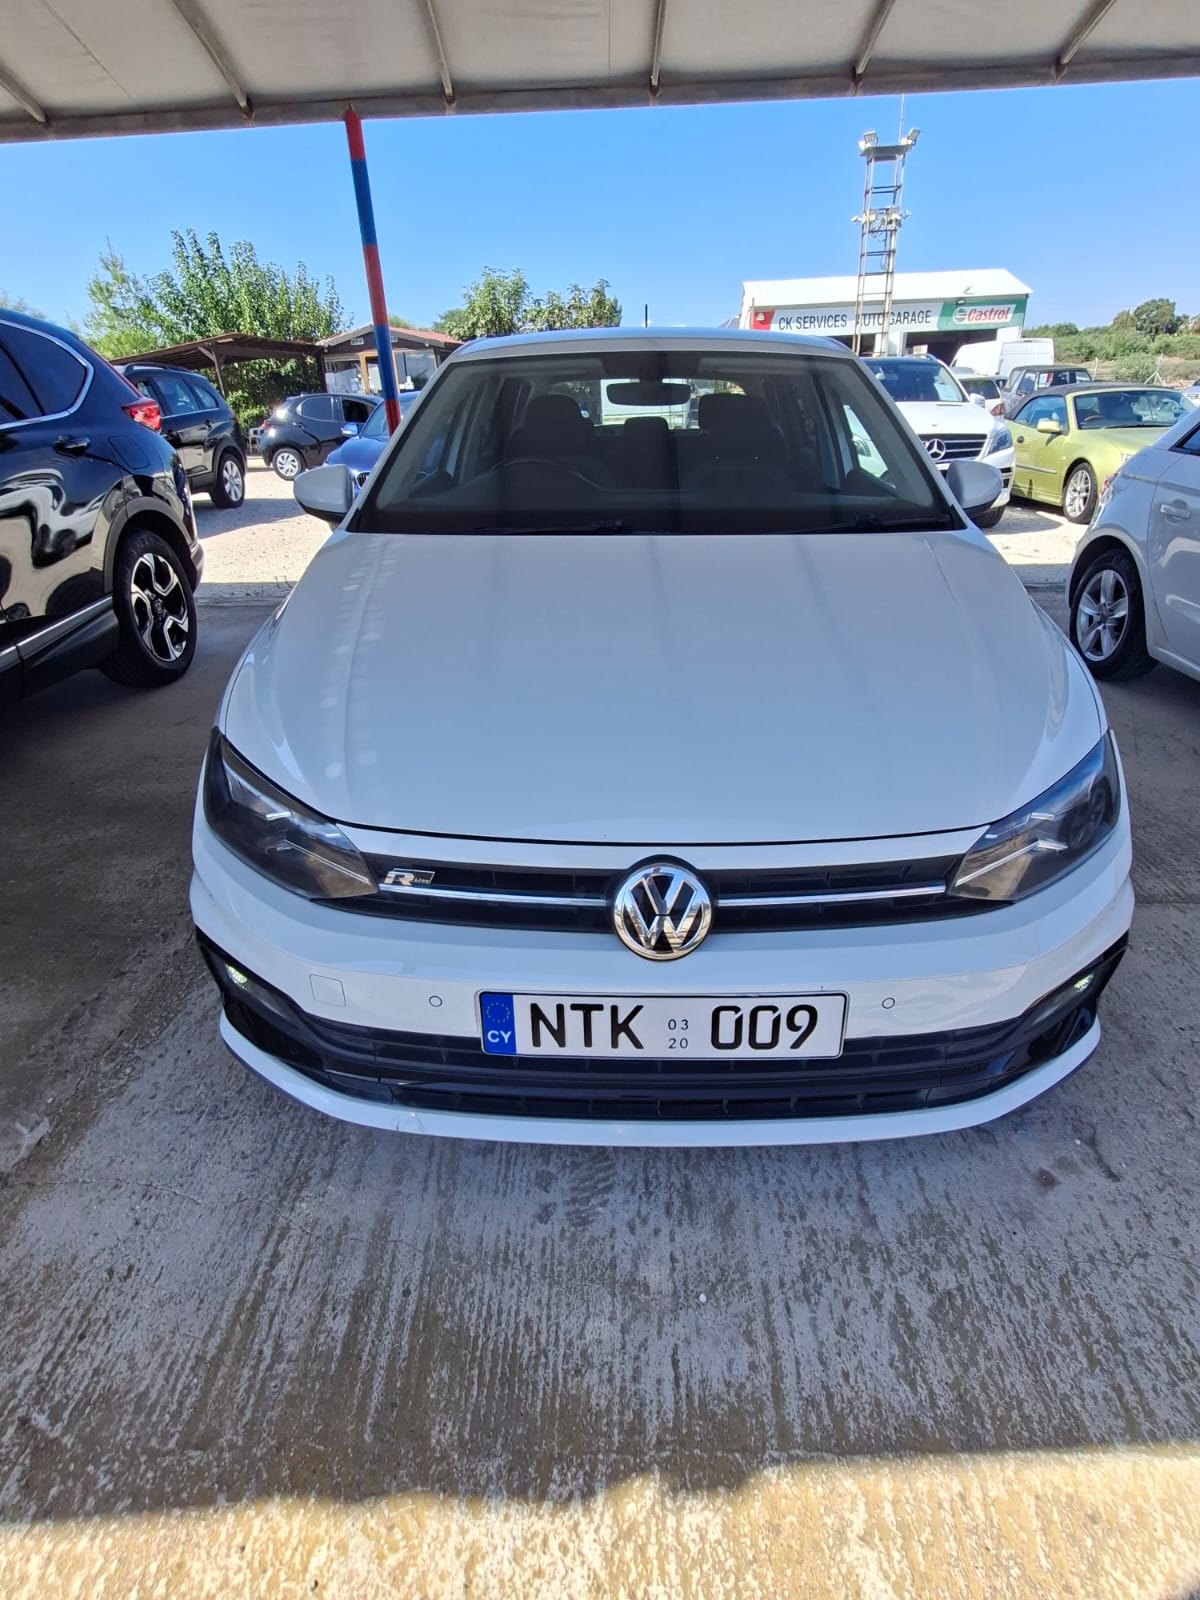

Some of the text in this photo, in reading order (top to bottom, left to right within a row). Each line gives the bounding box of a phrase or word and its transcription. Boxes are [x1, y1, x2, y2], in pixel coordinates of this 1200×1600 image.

[778, 316, 793, 331] CK
[795, 314, 848, 330] SERVICES
[888, 310, 932, 326] GARAGE
[967, 305, 1011, 322] Castrol
[384, 871, 415, 886] R
[617, 866, 709, 959] VW
[530, 1002, 818, 1051] NTK 009
[667, 1018, 689, 1031] 03
[487, 1030, 512, 1044] CY
[668, 1037, 689, 1050] 20
